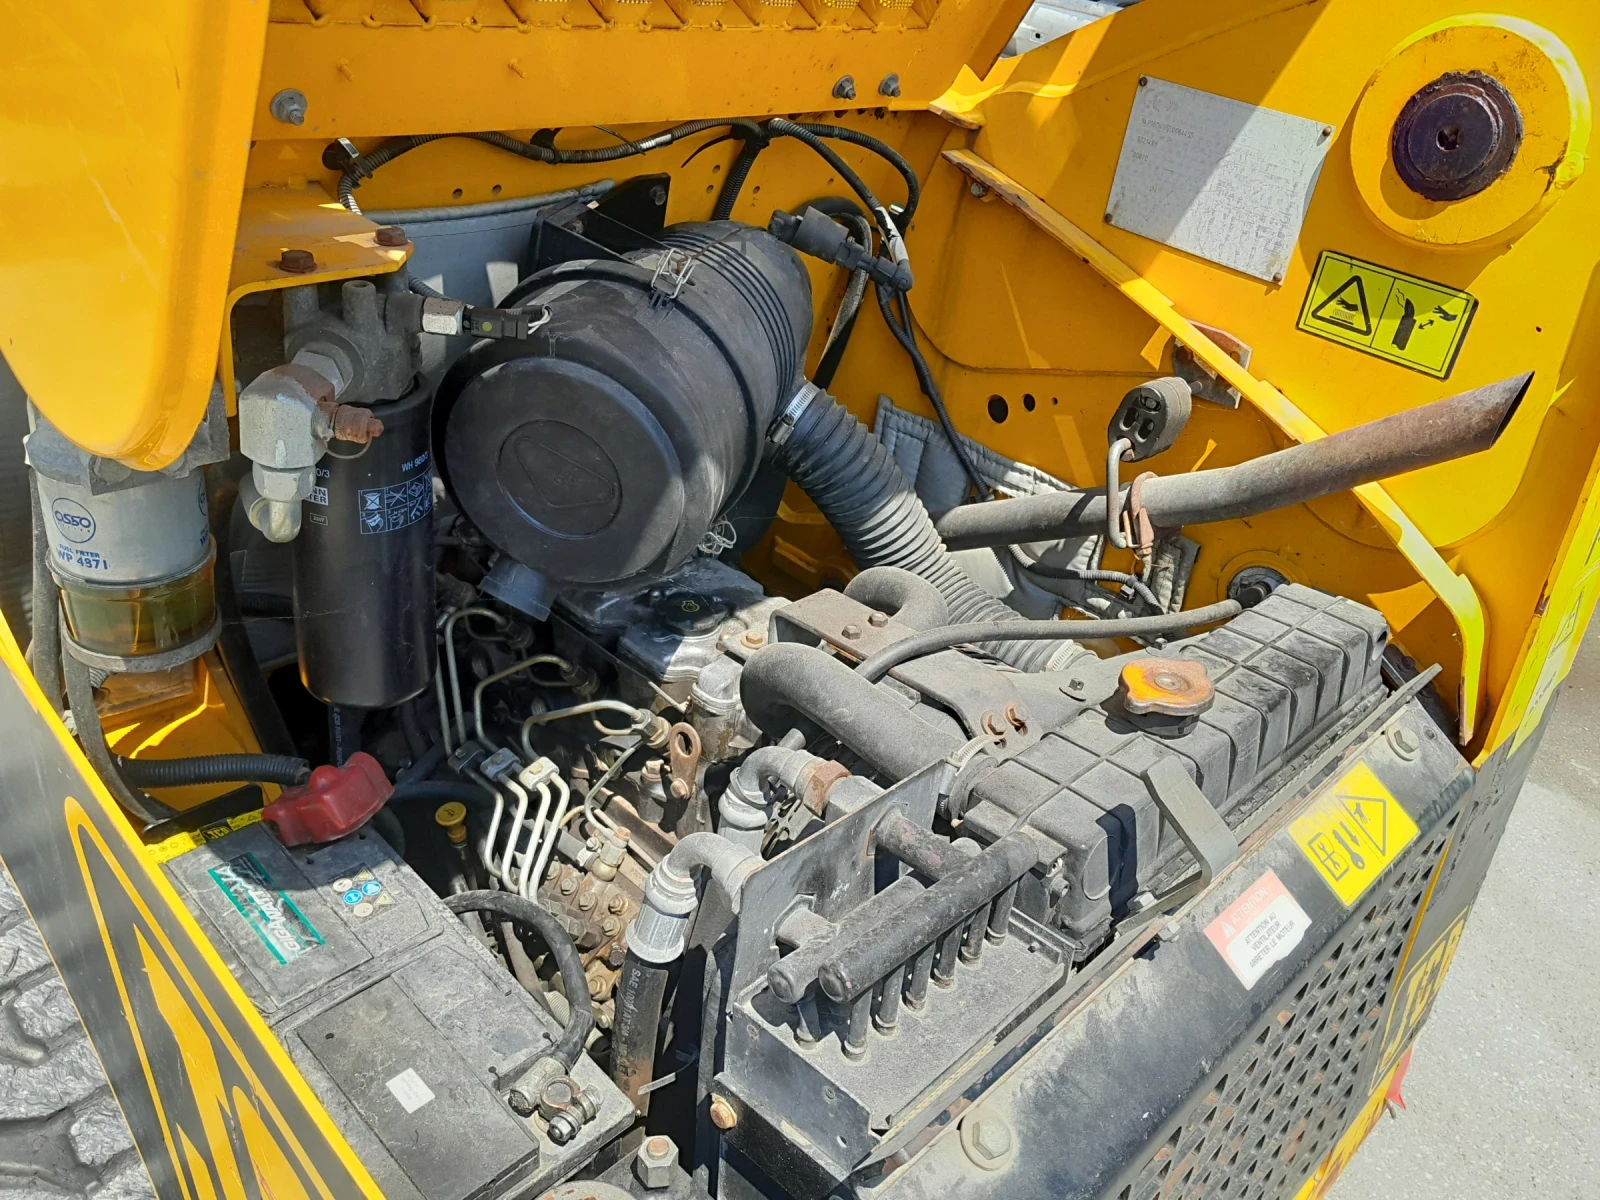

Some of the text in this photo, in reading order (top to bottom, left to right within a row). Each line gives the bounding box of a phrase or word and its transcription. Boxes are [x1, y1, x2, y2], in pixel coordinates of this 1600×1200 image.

[315, 468, 330, 478] 0/3
[313, 487, 326, 496] NN
[76, 550, 100, 558] FILTER
[1245, 911, 1277, 945] ATTENTION AU
[1251, 920, 1282, 951] VENTILATEUR
[1269, 938, 1278, 948] LE
[1276, 920, 1295, 941] MOTEUR
[629, 968, 641, 988] SAE
